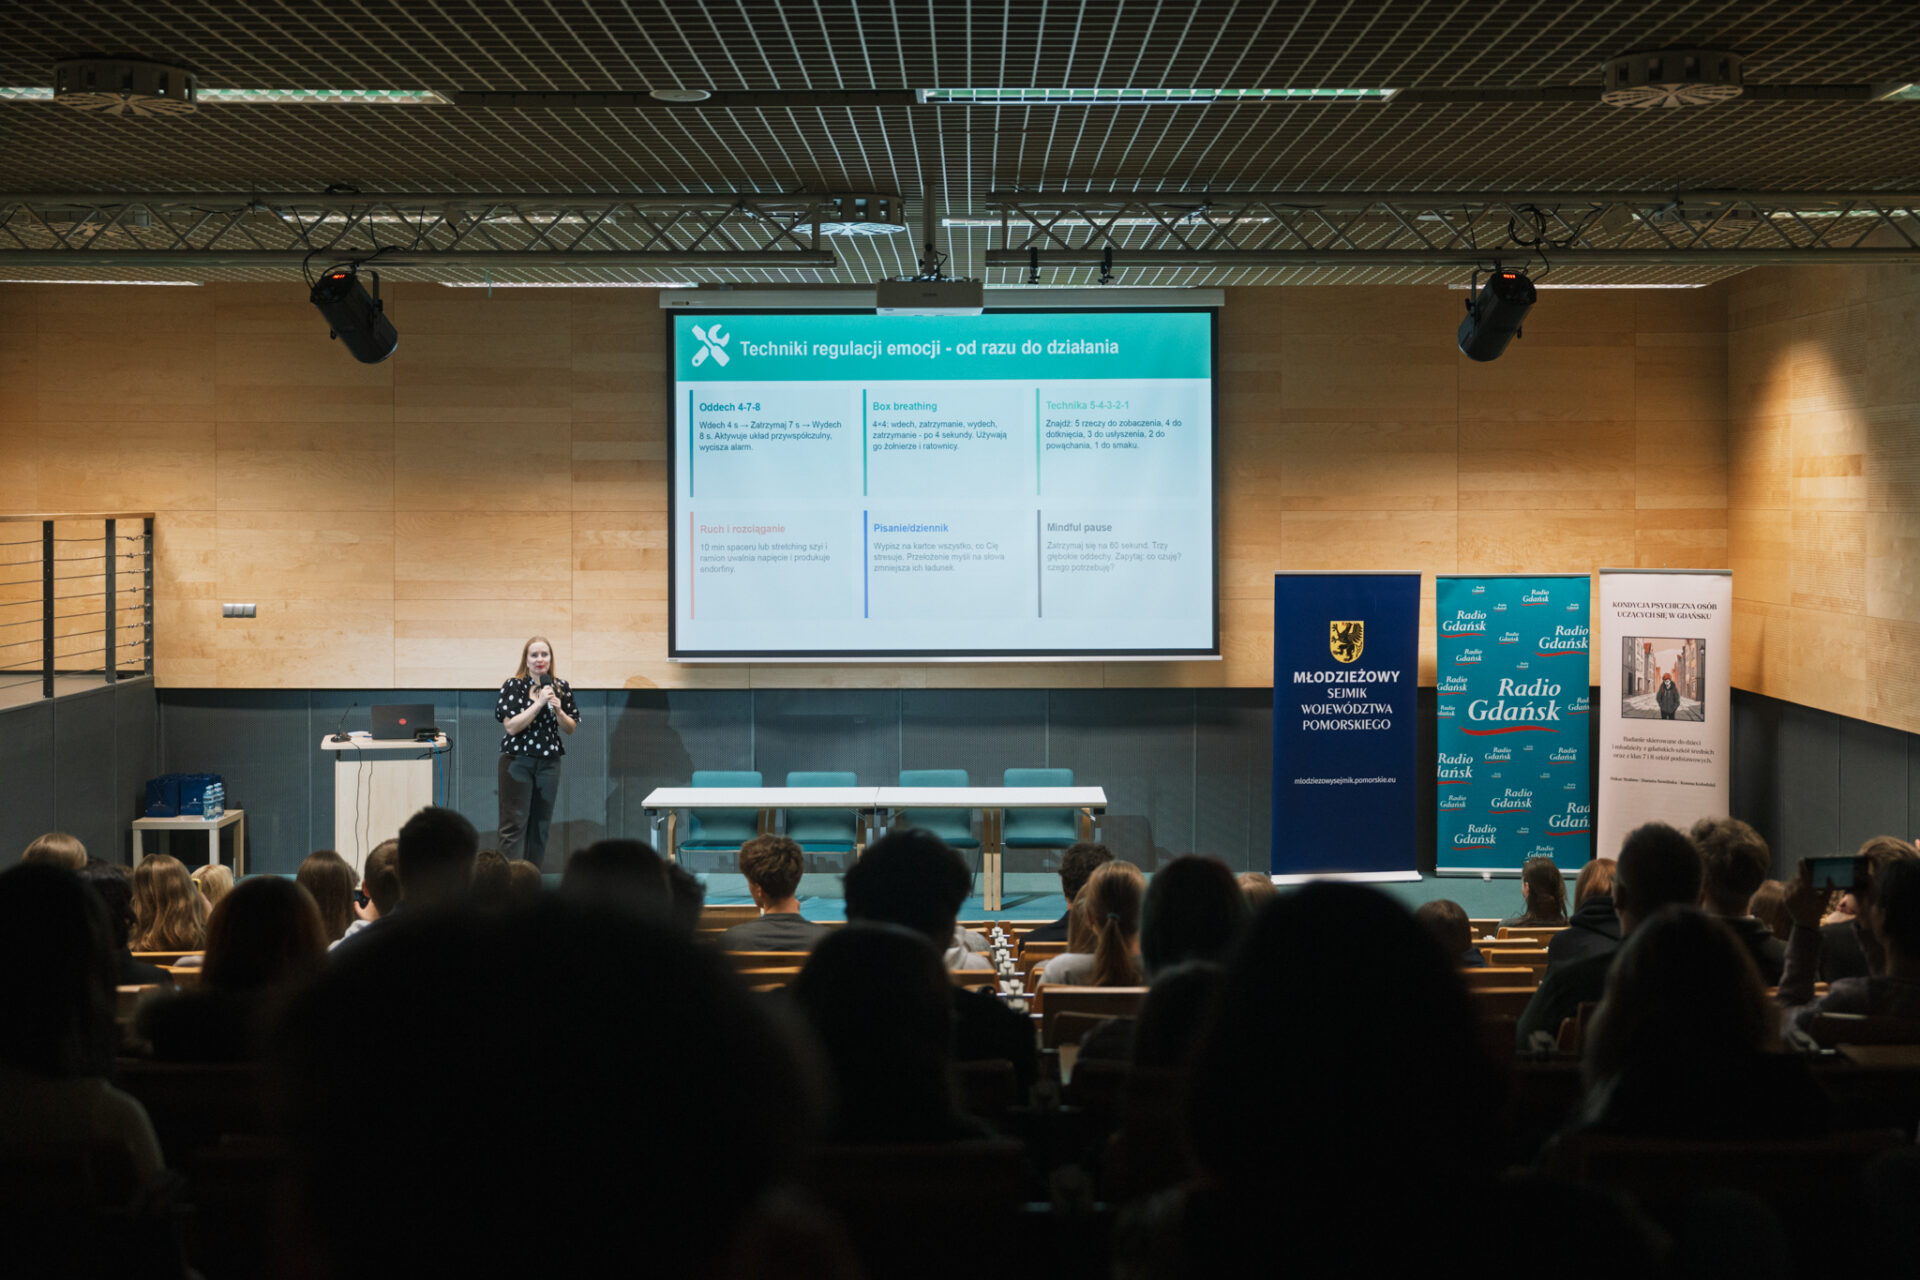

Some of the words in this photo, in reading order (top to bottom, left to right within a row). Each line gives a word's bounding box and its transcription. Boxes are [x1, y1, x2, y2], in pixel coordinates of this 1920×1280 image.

[740, 340, 807, 356] Techniki
[812, 340, 882, 359] regulacji
[887, 340, 941, 359] emocji
[956, 340, 977, 355] od
[982, 343, 1016, 355] razu
[1021, 339, 1042, 355] do
[1047, 339, 1119, 354] działania
[699, 403, 735, 411] Oddech
[738, 403, 760, 411] 4-7-8
[873, 402, 890, 411] Box
[893, 402, 937, 412] breathing
[1046, 401, 1087, 410] Technika
[1090, 401, 1129, 409] 5-4-3-2-1
[699, 421, 725, 429] Wdech
[727, 421, 732, 429] 4
[751, 421, 787, 430] Zatrzymaj
[812, 421, 841, 430] Wydech
[891, 421, 917, 429] wdech,
[919, 421, 965, 429] zatrzymanie,
[967, 420, 997, 429] wydech,
[1082, 421, 1105, 429] rzeczy
[1119, 419, 1163, 428] zobaczenia,
[1172, 419, 1182, 427] do
[700, 432, 704, 440] 8
[714, 432, 747, 441] Aktywuje
[750, 432, 769, 440] układ
[873, 431, 917, 440] zatrzymanie
[942, 431, 973, 440] sekundy.
[976, 430, 1007, 440] Używają
[1088, 430, 1092, 438] 3
[1094, 430, 1104, 438] do
[1106, 430, 1147, 439] usłyszenia,
[699, 444, 729, 452] wycisza
[731, 443, 753, 451] alarm.
[884, 442, 917, 450] żołnierze
[923, 442, 959, 451] ratownicy.
[1101, 441, 1110, 449] do
[1113, 441, 1139, 449] smaku.
[700, 525, 724, 533] Ruch
[732, 524, 785, 535] rozciąganie
[874, 523, 949, 532] Pisanie/dziennik
[1047, 523, 1081, 532] Mindful
[1084, 524, 1112, 533] pause
[771, 543, 807, 552] stretching
[874, 543, 900, 551] Wypisz
[1047, 542, 1084, 551] Zatrzymaj
[1152, 541, 1168, 550] Trzy
[794, 554, 830, 562] produkuje
[1697, 602, 1717, 610] OSÓB
[1457, 610, 1487, 619] Radio
[1442, 620, 1486, 631] Gdańsk
[1555, 625, 1589, 636] Radio
[1539, 637, 1588, 649] Gdańsk
[1294, 669, 1400, 683] MŁODZIEŻOWY
[1497, 678, 1561, 697] Radio
[1327, 687, 1367, 699] SEJMIK
[1301, 701, 1393, 715] WOJEWÓDZTWA
[1468, 699, 1562, 721] Gdańsk
[1303, 719, 1391, 731] POMORSKIEGO
[1438, 753, 1473, 764] Radio
[1550, 753, 1576, 761] Gdańsk
[1505, 788, 1532, 797] Radio
[1491, 798, 1532, 808] Gdańsk
[1549, 814, 1590, 828] Gdań
[1468, 824, 1496, 833] Radio
[1454, 834, 1496, 844] Gdańsk
